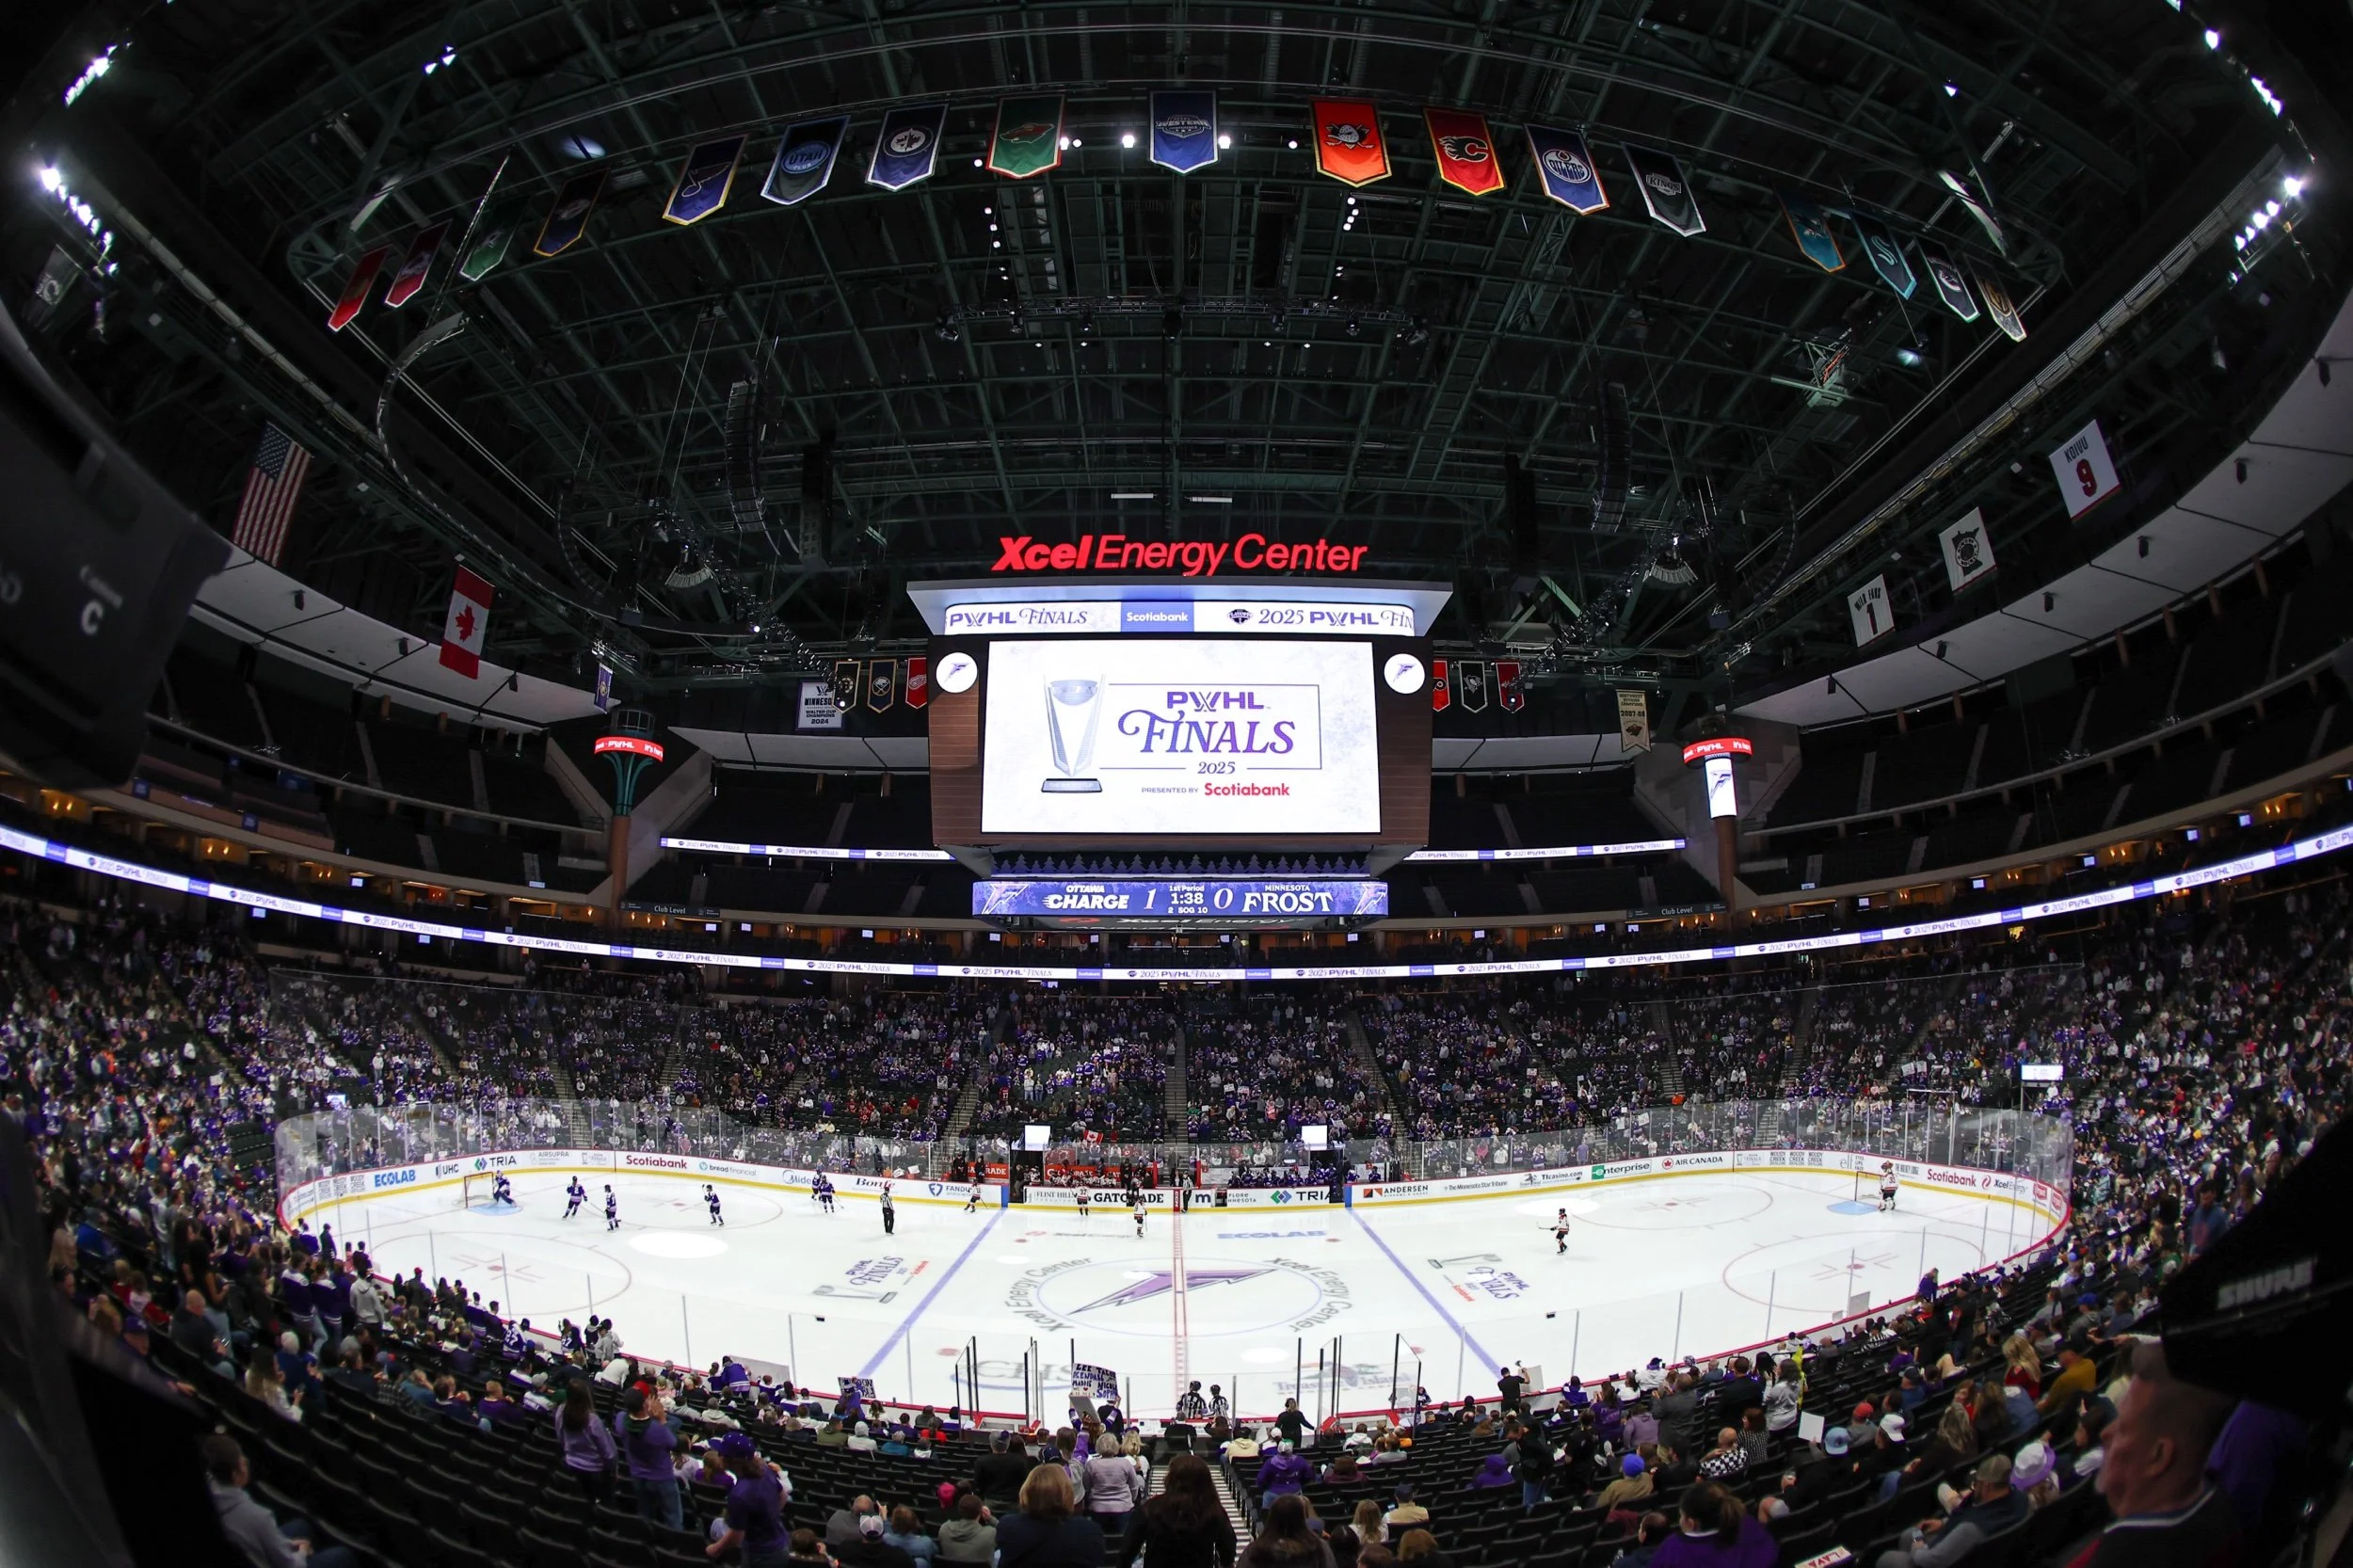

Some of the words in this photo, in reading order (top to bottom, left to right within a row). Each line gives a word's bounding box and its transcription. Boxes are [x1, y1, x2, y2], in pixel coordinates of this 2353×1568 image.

[789, 150, 825, 165] UTAH
[1548, 159, 1585, 180] OILERS
[1649, 177, 1680, 192] KINGS
[2064, 436, 2089, 464] KOIVU
[2075, 457, 2098, 498] 9
[991, 535, 1094, 570] Xcel
[1095, 535, 1229, 577] Energy
[1234, 533, 1368, 571] Center
[950, 612, 1016, 627] PWHL
[1018, 607, 1088, 624] FINALS
[1126, 612, 1188, 623] Scotiabank
[1258, 609, 1305, 624] 2025
[1309, 611, 1379, 626] PWHL
[1866, 602, 1878, 635] 1
[1167, 691, 1264, 712] PWHL
[1118, 710, 1295, 754] FINALS
[1197, 761, 1236, 775] 2025
[1204, 783, 1289, 796] Scotiabank
[1066, 885, 1105, 893] OTTAWA
[1046, 893, 1129, 909] CHARGE
[1143, 888, 1156, 910] 1
[1171, 892, 1204, 904] 1:38
[1214, 888, 1232, 909] 0
[1241, 892, 1334, 912] FROST
[2069, 898, 2090, 909] PWHL
[669, 906, 686, 915] Level
[392, 920, 416, 931] PWHL
[1932, 922, 1956, 931] PWHL
[536, 939, 562, 951] PWHL
[1787, 941, 1813, 951] PWHL
[685, 953, 712, 963] PWHL
[1638, 954, 1664, 963] PWHL
[837, 963, 863, 972] PWHL
[994, 968, 1023, 977] PWHL
[1329, 968, 1357, 977] PWHL
[1487, 964, 1514, 972] PWHL
[1161, 970, 1190, 979] PWHL
[488, 1155, 517, 1167] TRIA
[626, 1155, 688, 1170] Scotiabank
[1675, 1158, 1689, 1166] AIR
[1690, 1157, 1723, 1165] CANADA
[442, 1163, 459, 1176] UHC
[709, 1163, 729, 1174] bread
[729, 1165, 757, 1176] financial
[375, 1169, 416, 1187] ECOLAB
[790, 1174, 811, 1185] Mide
[1928, 1169, 1977, 1187] Scotiabank
[1993, 1179, 2009, 1189] Xcel
[1385, 1185, 1428, 1193] ANDERSEN
[1094, 1192, 1164, 1204] GATOADE
[1217, 1230, 1326, 1239] ECOLAB
[850, 1256, 904, 1286] FINALS
[1026, 1257, 1093, 1278] Center
[1263, 1257, 1322, 1272] Xcel
[1310, 1271, 1351, 1299] Energy
[1005, 1278, 1038, 1307] Energy
[1013, 1310, 1076, 1332] Xcel
[1289, 1301, 1353, 1333] Center
